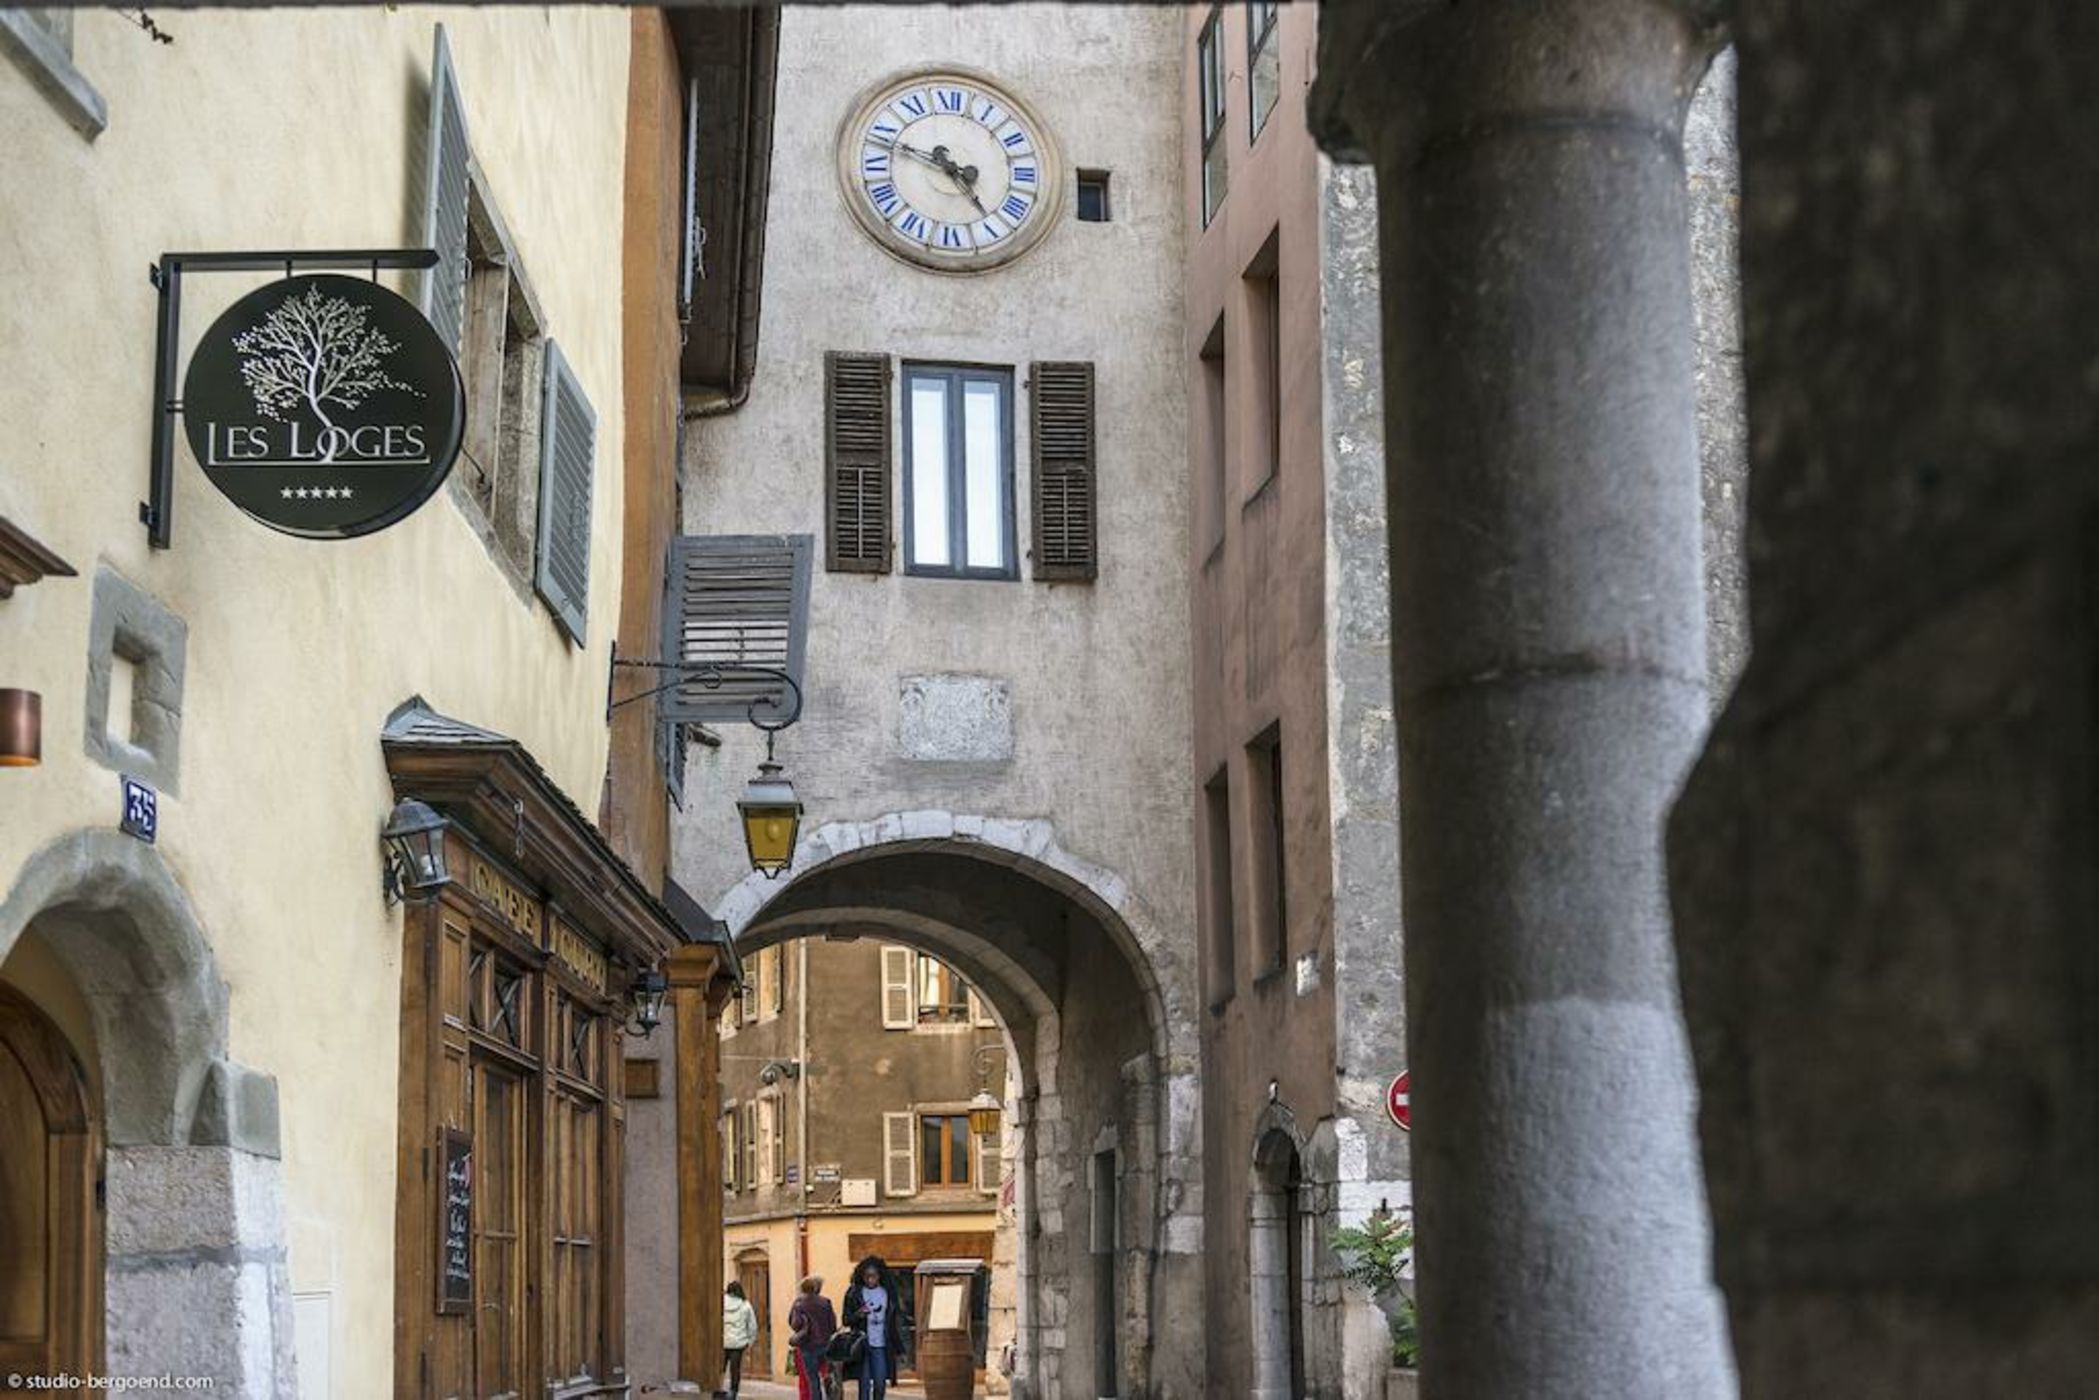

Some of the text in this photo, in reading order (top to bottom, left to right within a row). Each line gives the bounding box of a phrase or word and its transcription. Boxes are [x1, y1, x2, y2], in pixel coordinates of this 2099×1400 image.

[937, 90, 962, 112] XII
[980, 104, 994, 122] I
[1003, 132, 1025, 147] II
[1013, 167, 1036, 184] III
[207, 420, 426, 466] LES LOGES
[129, 784, 154, 831] 35
